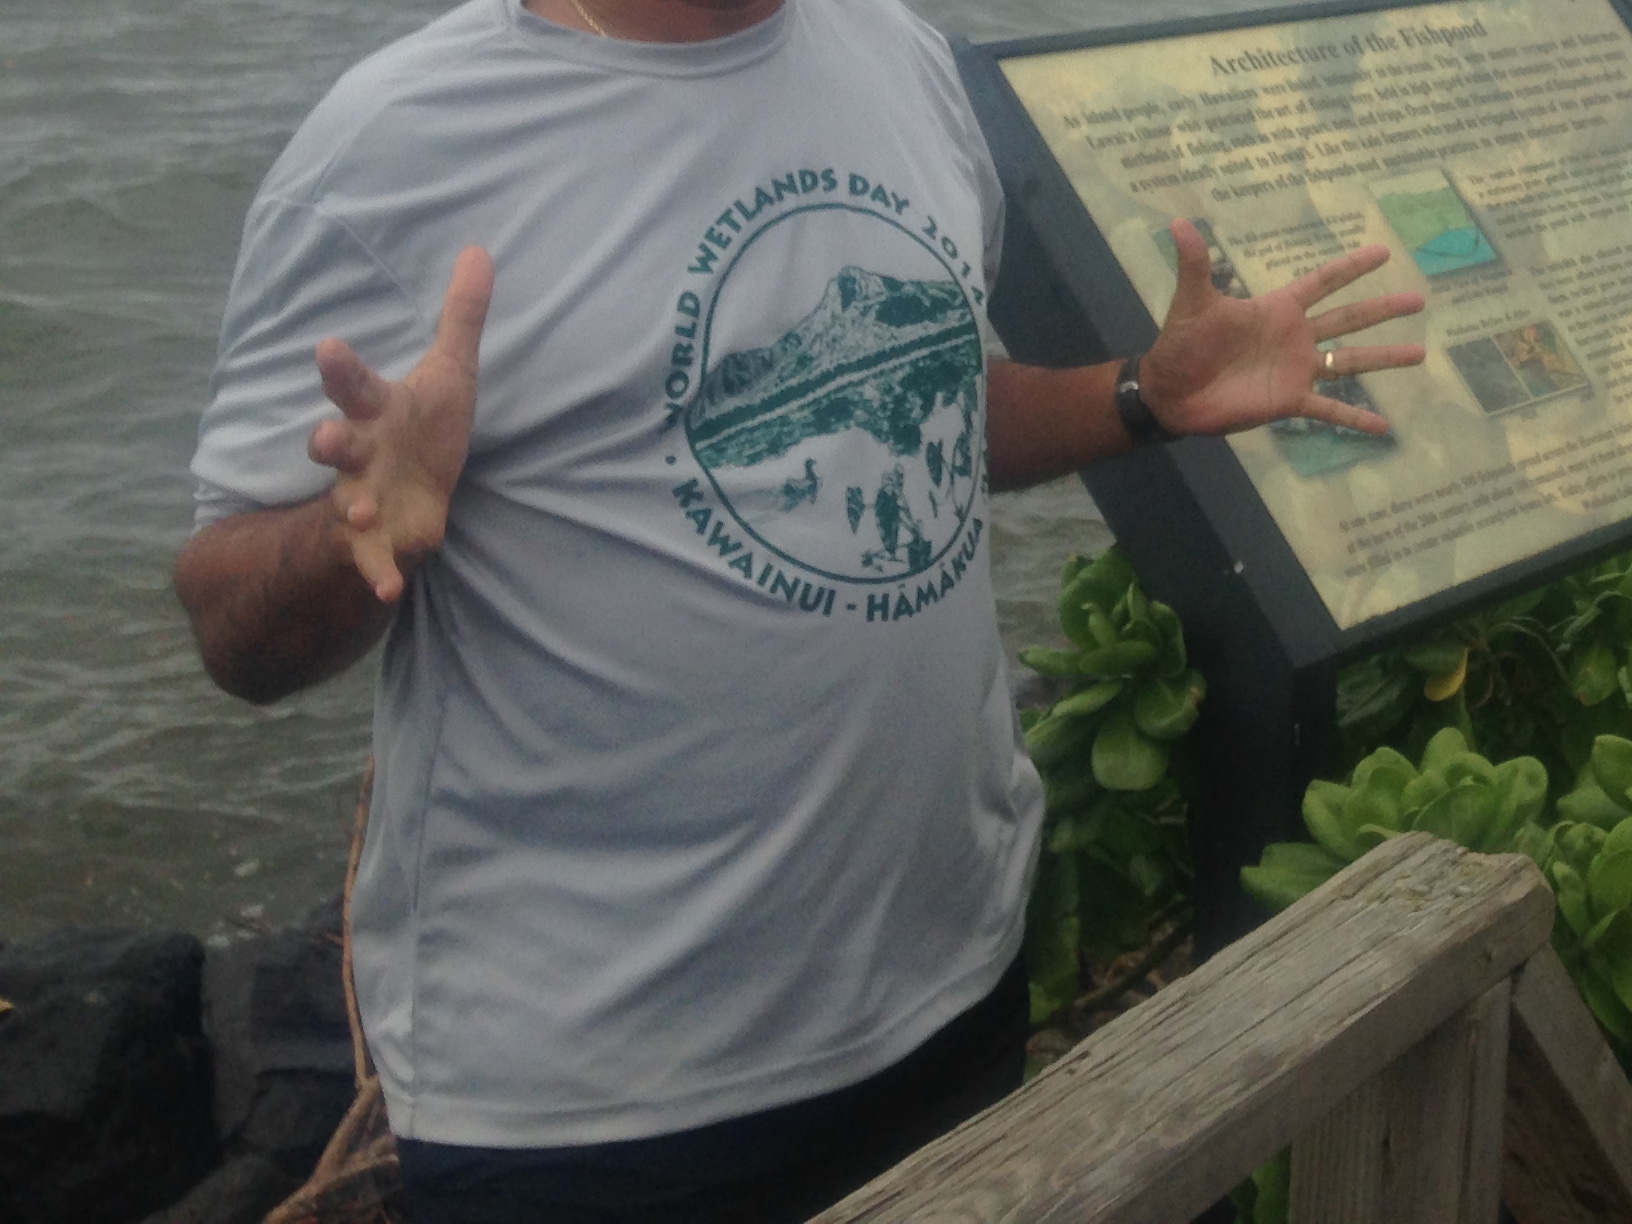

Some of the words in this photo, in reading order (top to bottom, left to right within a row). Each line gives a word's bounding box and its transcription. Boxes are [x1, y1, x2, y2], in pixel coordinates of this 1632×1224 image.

[1209, 44, 1339, 76] Architecture
[1342, 34, 1364, 56] of
[1365, 31, 1398, 51] the
[1397, 18, 1487, 47] Fishpond
[688, 168, 837, 277] WETLANDS
[848, 172, 911, 216] DAY
[922, 216, 988, 306] 2014
[672, 477, 836, 616] KAWAINUI
